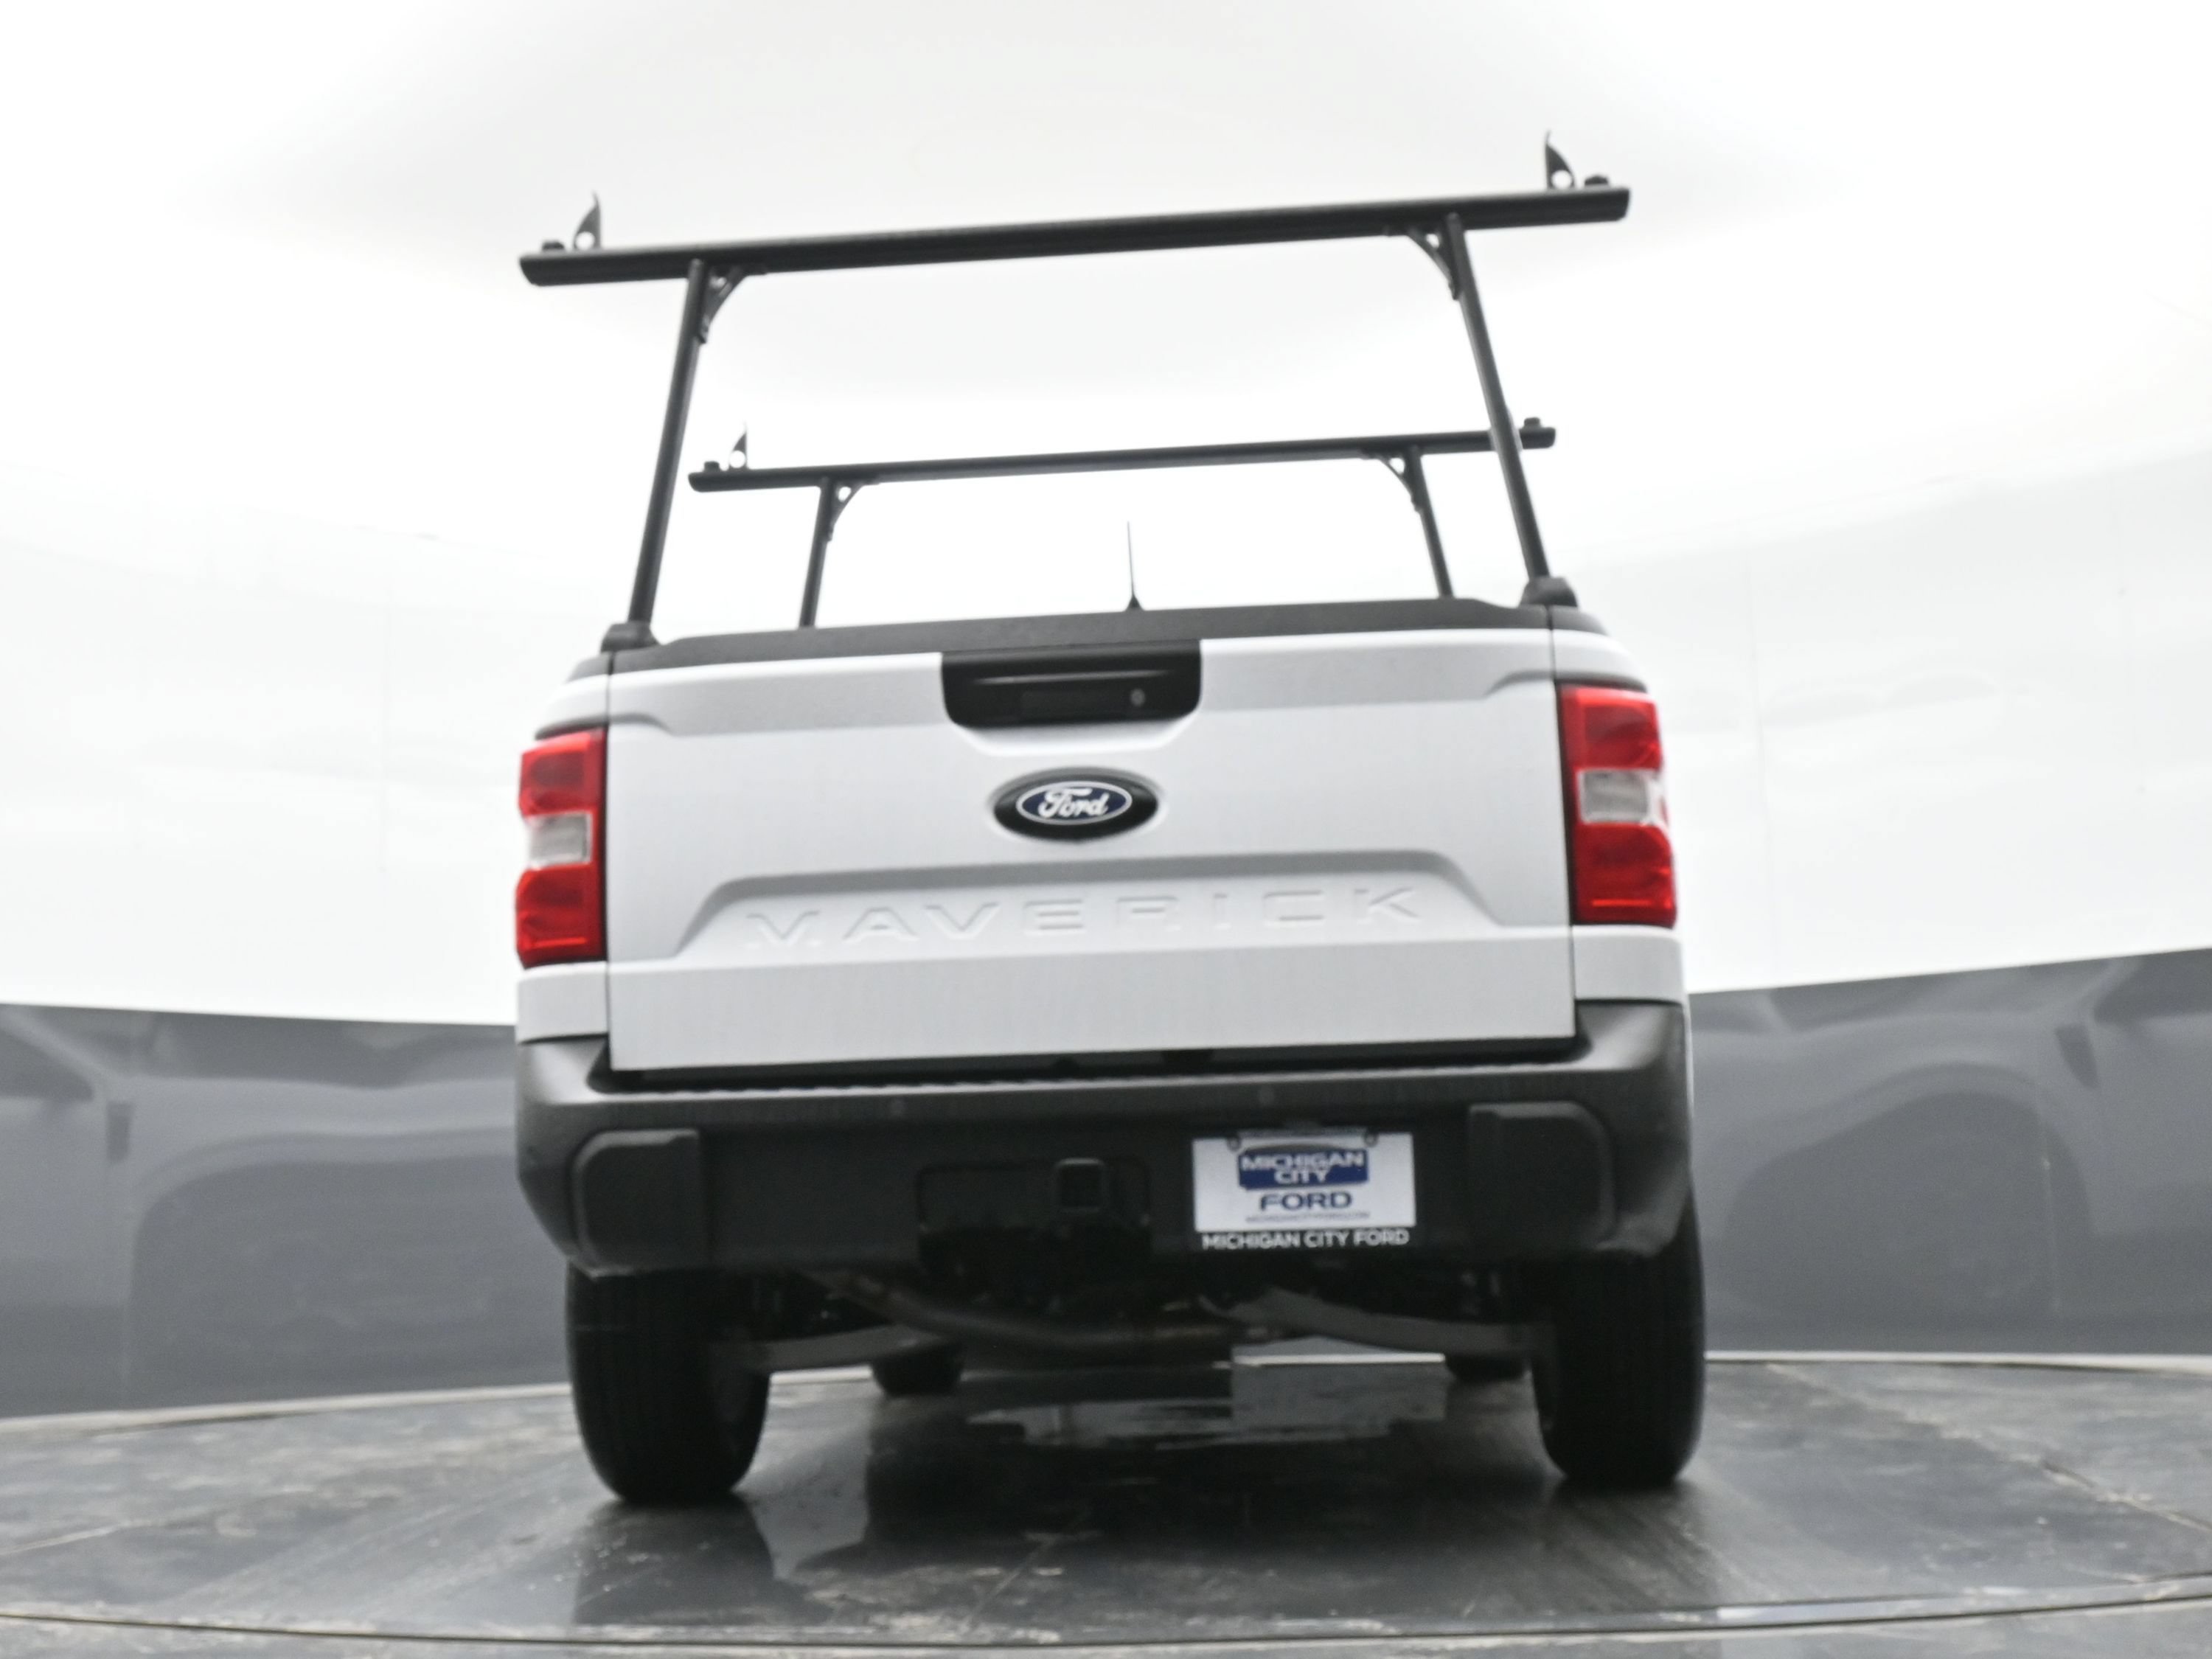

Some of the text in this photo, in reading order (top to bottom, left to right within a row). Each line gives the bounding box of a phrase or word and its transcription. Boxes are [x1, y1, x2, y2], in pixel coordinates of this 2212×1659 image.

[1038, 787, 1110, 818] Ford
[745, 888, 1420, 949] MAVERICK
[1241, 1151, 1363, 1172] MICHIGAN
[1273, 1169, 1329, 1184] CITY
[1259, 1191, 1353, 1211] FORD
[1202, 1228, 1410, 1250] MICHIGAN CITY FORD
